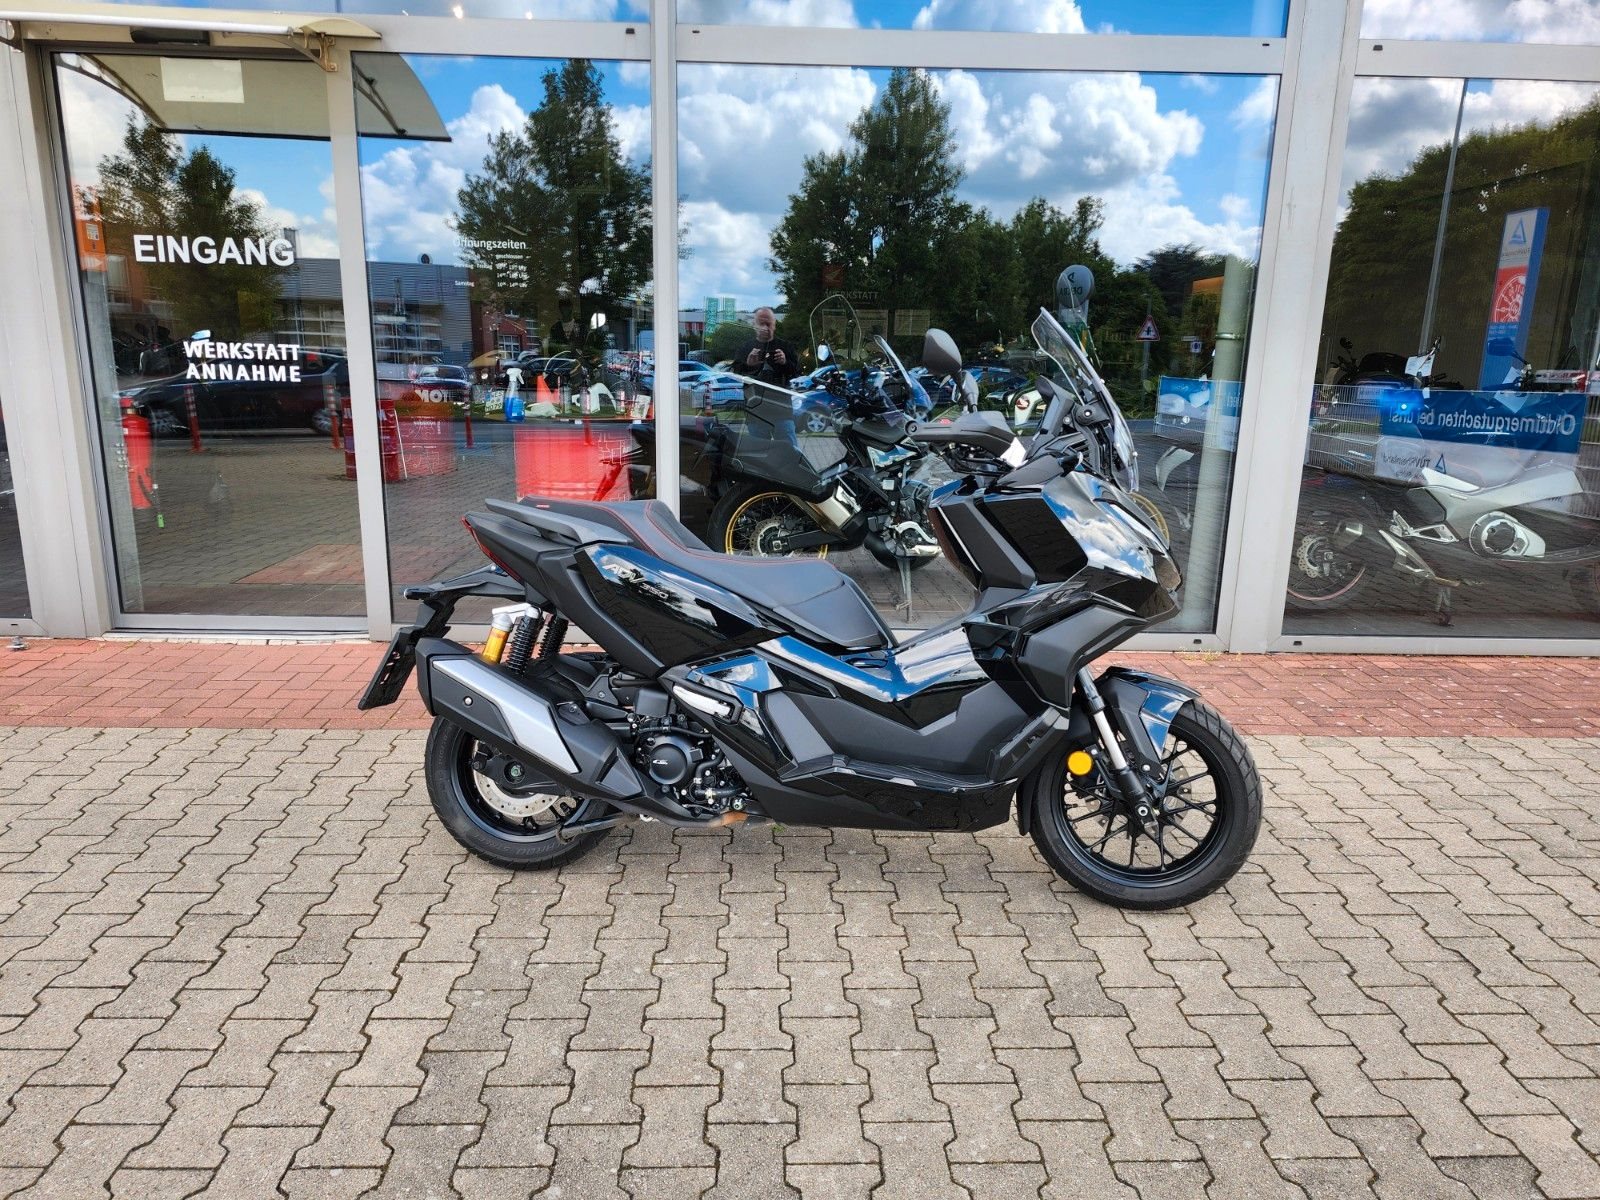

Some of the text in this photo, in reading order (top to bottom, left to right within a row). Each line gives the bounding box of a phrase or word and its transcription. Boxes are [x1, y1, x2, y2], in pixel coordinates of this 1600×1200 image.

[133, 234, 295, 267] EINGANG
[183, 340, 300, 361] WERKSTATT
[186, 363, 301, 382] ANNAHME
[602, 563, 646, 584] ADV
